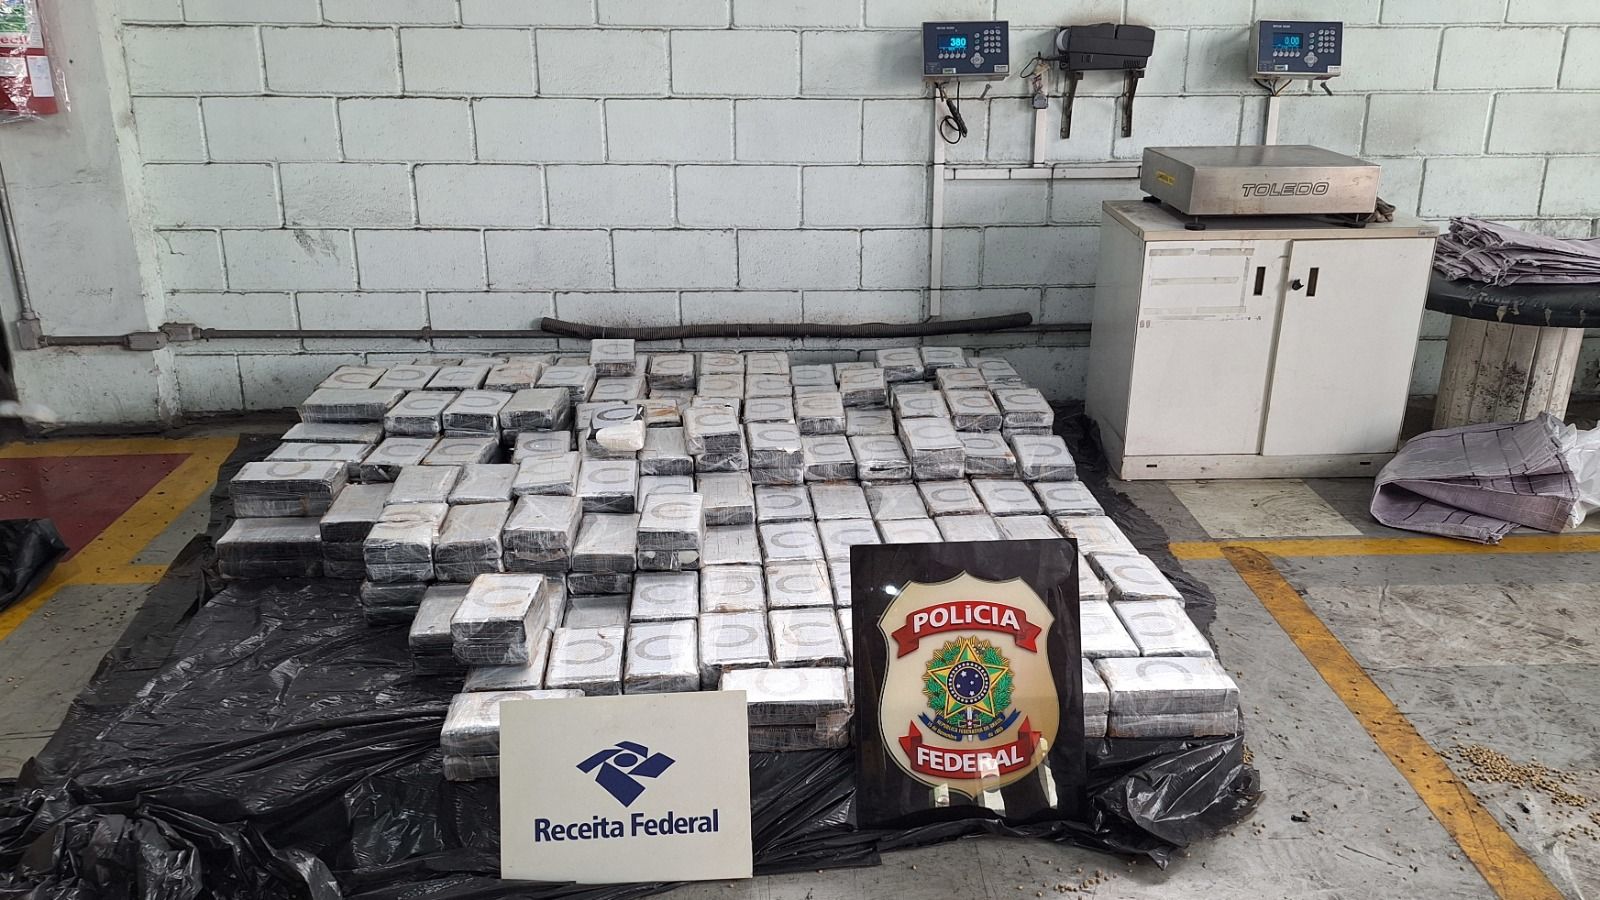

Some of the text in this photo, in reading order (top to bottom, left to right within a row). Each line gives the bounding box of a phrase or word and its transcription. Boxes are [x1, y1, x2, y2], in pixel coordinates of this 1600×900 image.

[950, 38, 966, 46] 380
[1242, 182, 1329, 197] TOLEDO
[917, 745, 1024, 772] FEDERAL
[534, 809, 719, 842] Receita Federal
